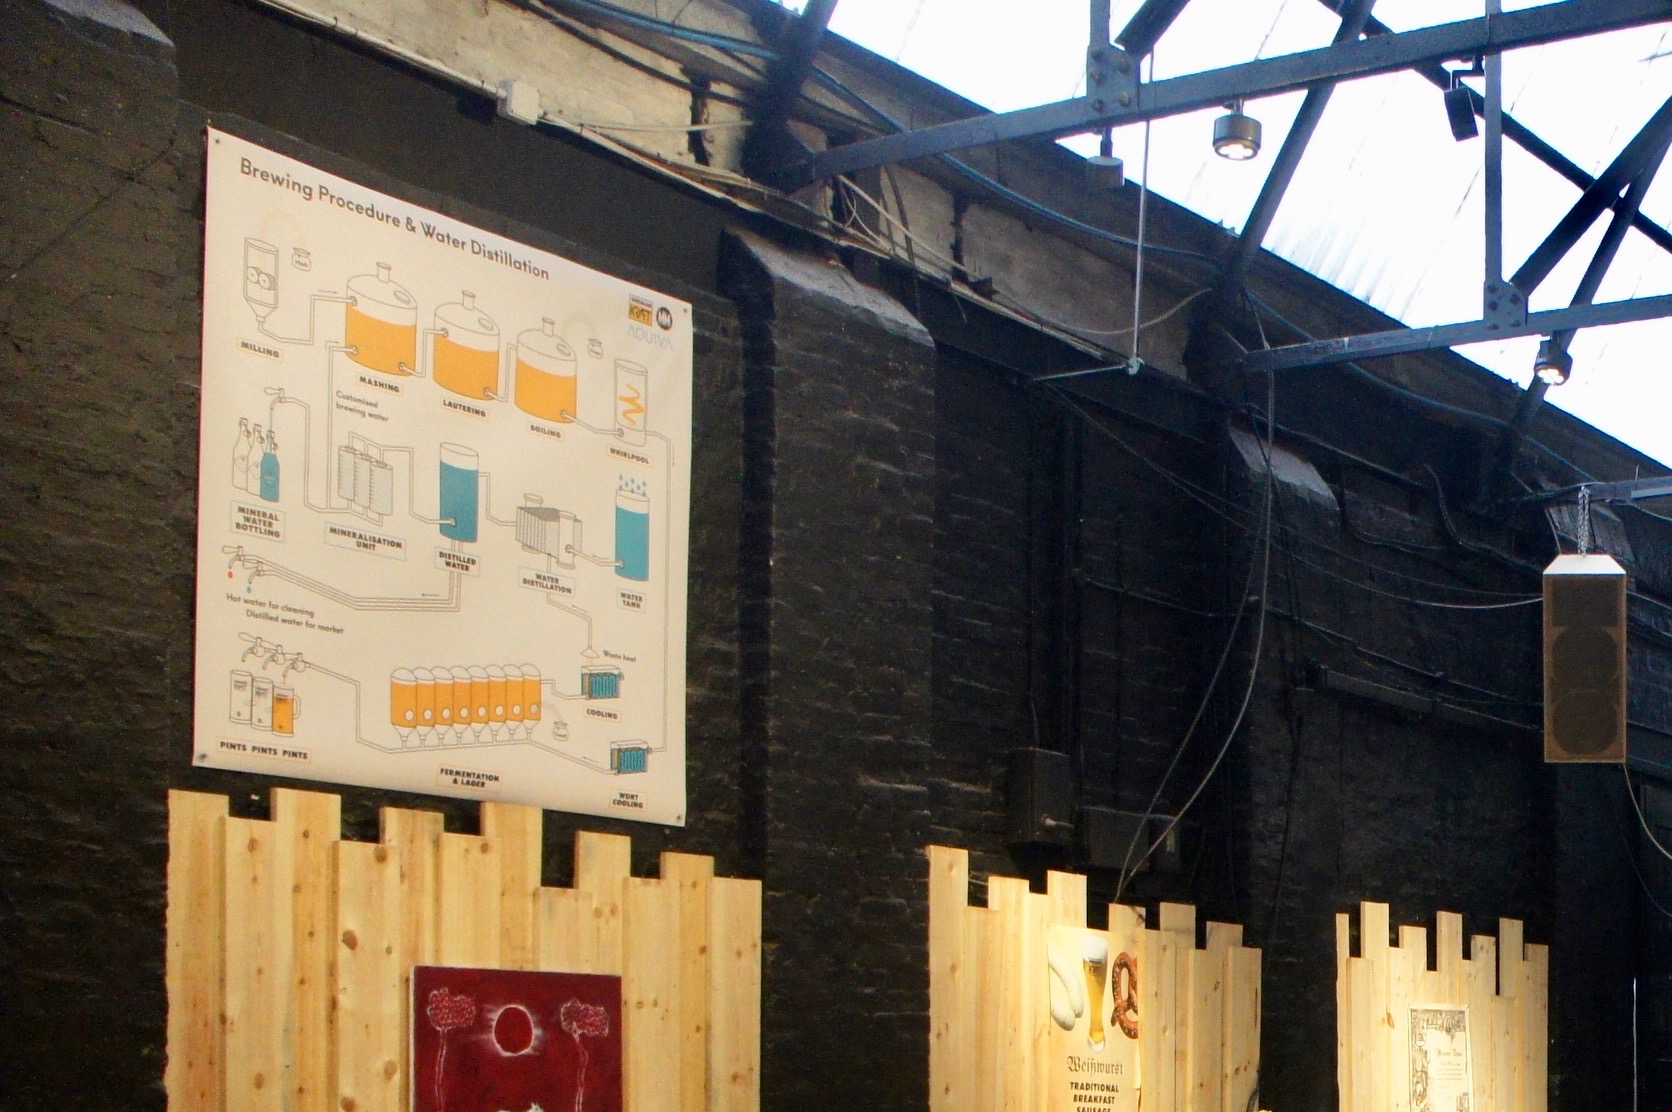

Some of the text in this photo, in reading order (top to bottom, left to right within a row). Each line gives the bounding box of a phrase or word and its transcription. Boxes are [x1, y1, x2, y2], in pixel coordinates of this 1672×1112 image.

[240, 157, 549, 280] Brewing Procedure & Water Distillation
[241, 341, 280, 358] MILLING
[359, 376, 400, 393] MASHING
[336, 402, 389, 422] brewing water
[443, 399, 486, 417] LAUTERING
[530, 424, 561, 438] BOILING
[610, 447, 649, 464] WHIRLPOOL
[238, 506, 279, 521] MINERAL
[243, 515, 273, 528] WATER
[235, 522, 280, 538] BOTTLING
[330, 526, 402, 548] MINERALISATION
[356, 541, 376, 551] UNIT
[439, 551, 476, 565] DISTILLED
[445, 560, 470, 571] WATER
[536, 573, 559, 584] WATER
[523, 578, 572, 594] DISTILLATION
[620, 592, 643, 602] WATER
[227, 593, 314, 618] Hot water for cleaning
[623, 600, 641, 609] TANK
[246, 609, 344, 634] Distilled water for market
[587, 708, 618, 720] COOLING
[220, 741, 308, 759] PINTS PINTS PINTS
[440, 768, 499, 782] FERMENTATION
[461, 779, 486, 788] LAGER
[619, 792, 639, 800] WORT
[613, 799, 643, 809] COOLING
[1070, 1082, 1119, 1092] TRADITIONAL
[1073, 1095, 1115, 1104] BREAKFAST
